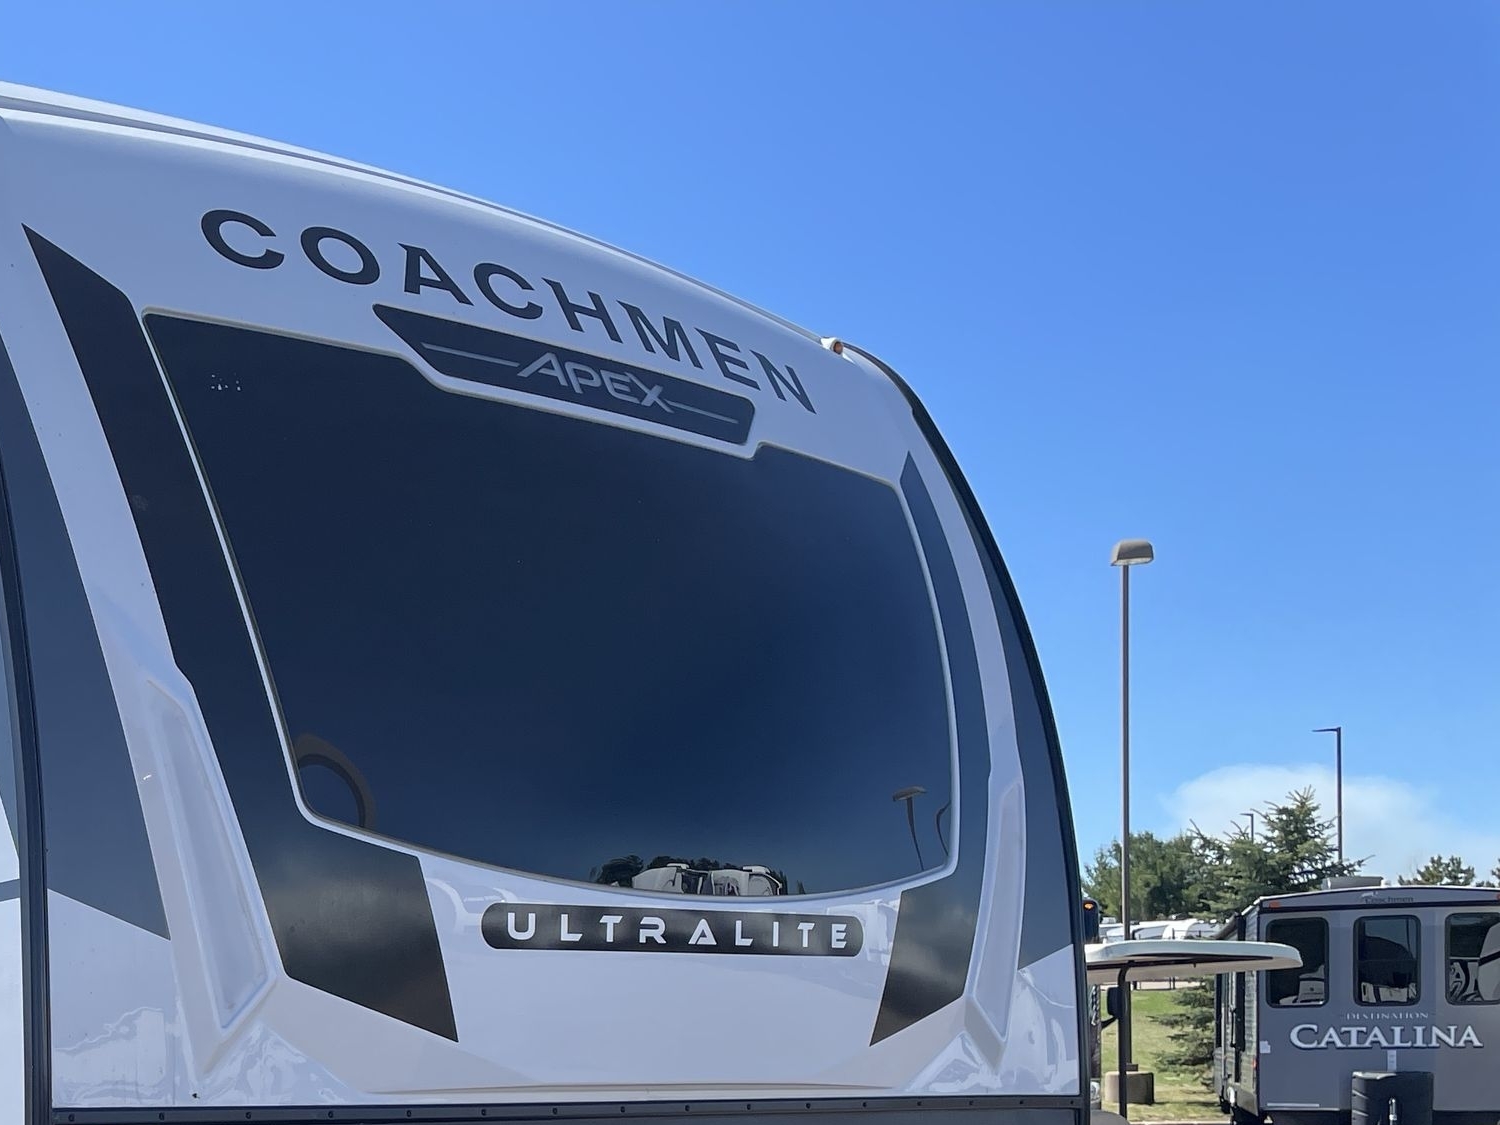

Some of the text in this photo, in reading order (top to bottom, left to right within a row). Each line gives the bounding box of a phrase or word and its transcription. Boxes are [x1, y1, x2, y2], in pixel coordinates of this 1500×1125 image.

[200, 208, 817, 416] COACHMEN
[516, 351, 675, 414] APEX
[506, 911, 849, 949] ULTRALITE
[1289, 1023, 1484, 1050] CATALINA
